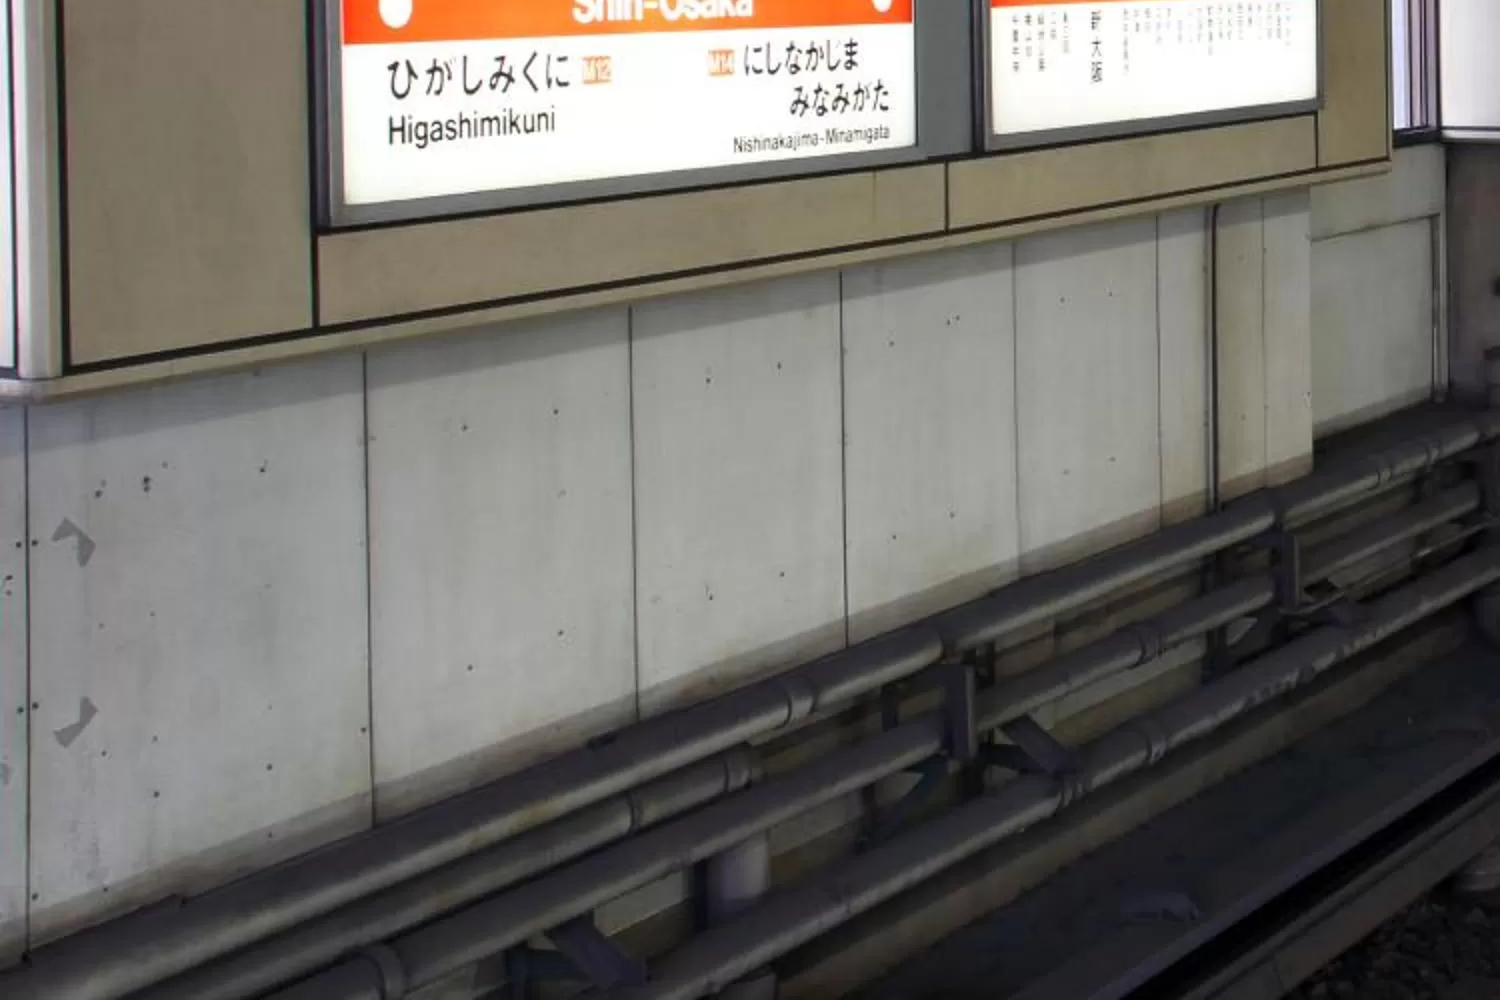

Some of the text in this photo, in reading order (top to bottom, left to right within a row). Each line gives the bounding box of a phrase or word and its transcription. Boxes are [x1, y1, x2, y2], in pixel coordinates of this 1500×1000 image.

[387, 51, 570, 100] ひがしみくに
[744, 38, 859, 76] にしなかじま
[789, 79, 889, 118] みなみがた
[388, 108, 556, 149] Higashimikuni
